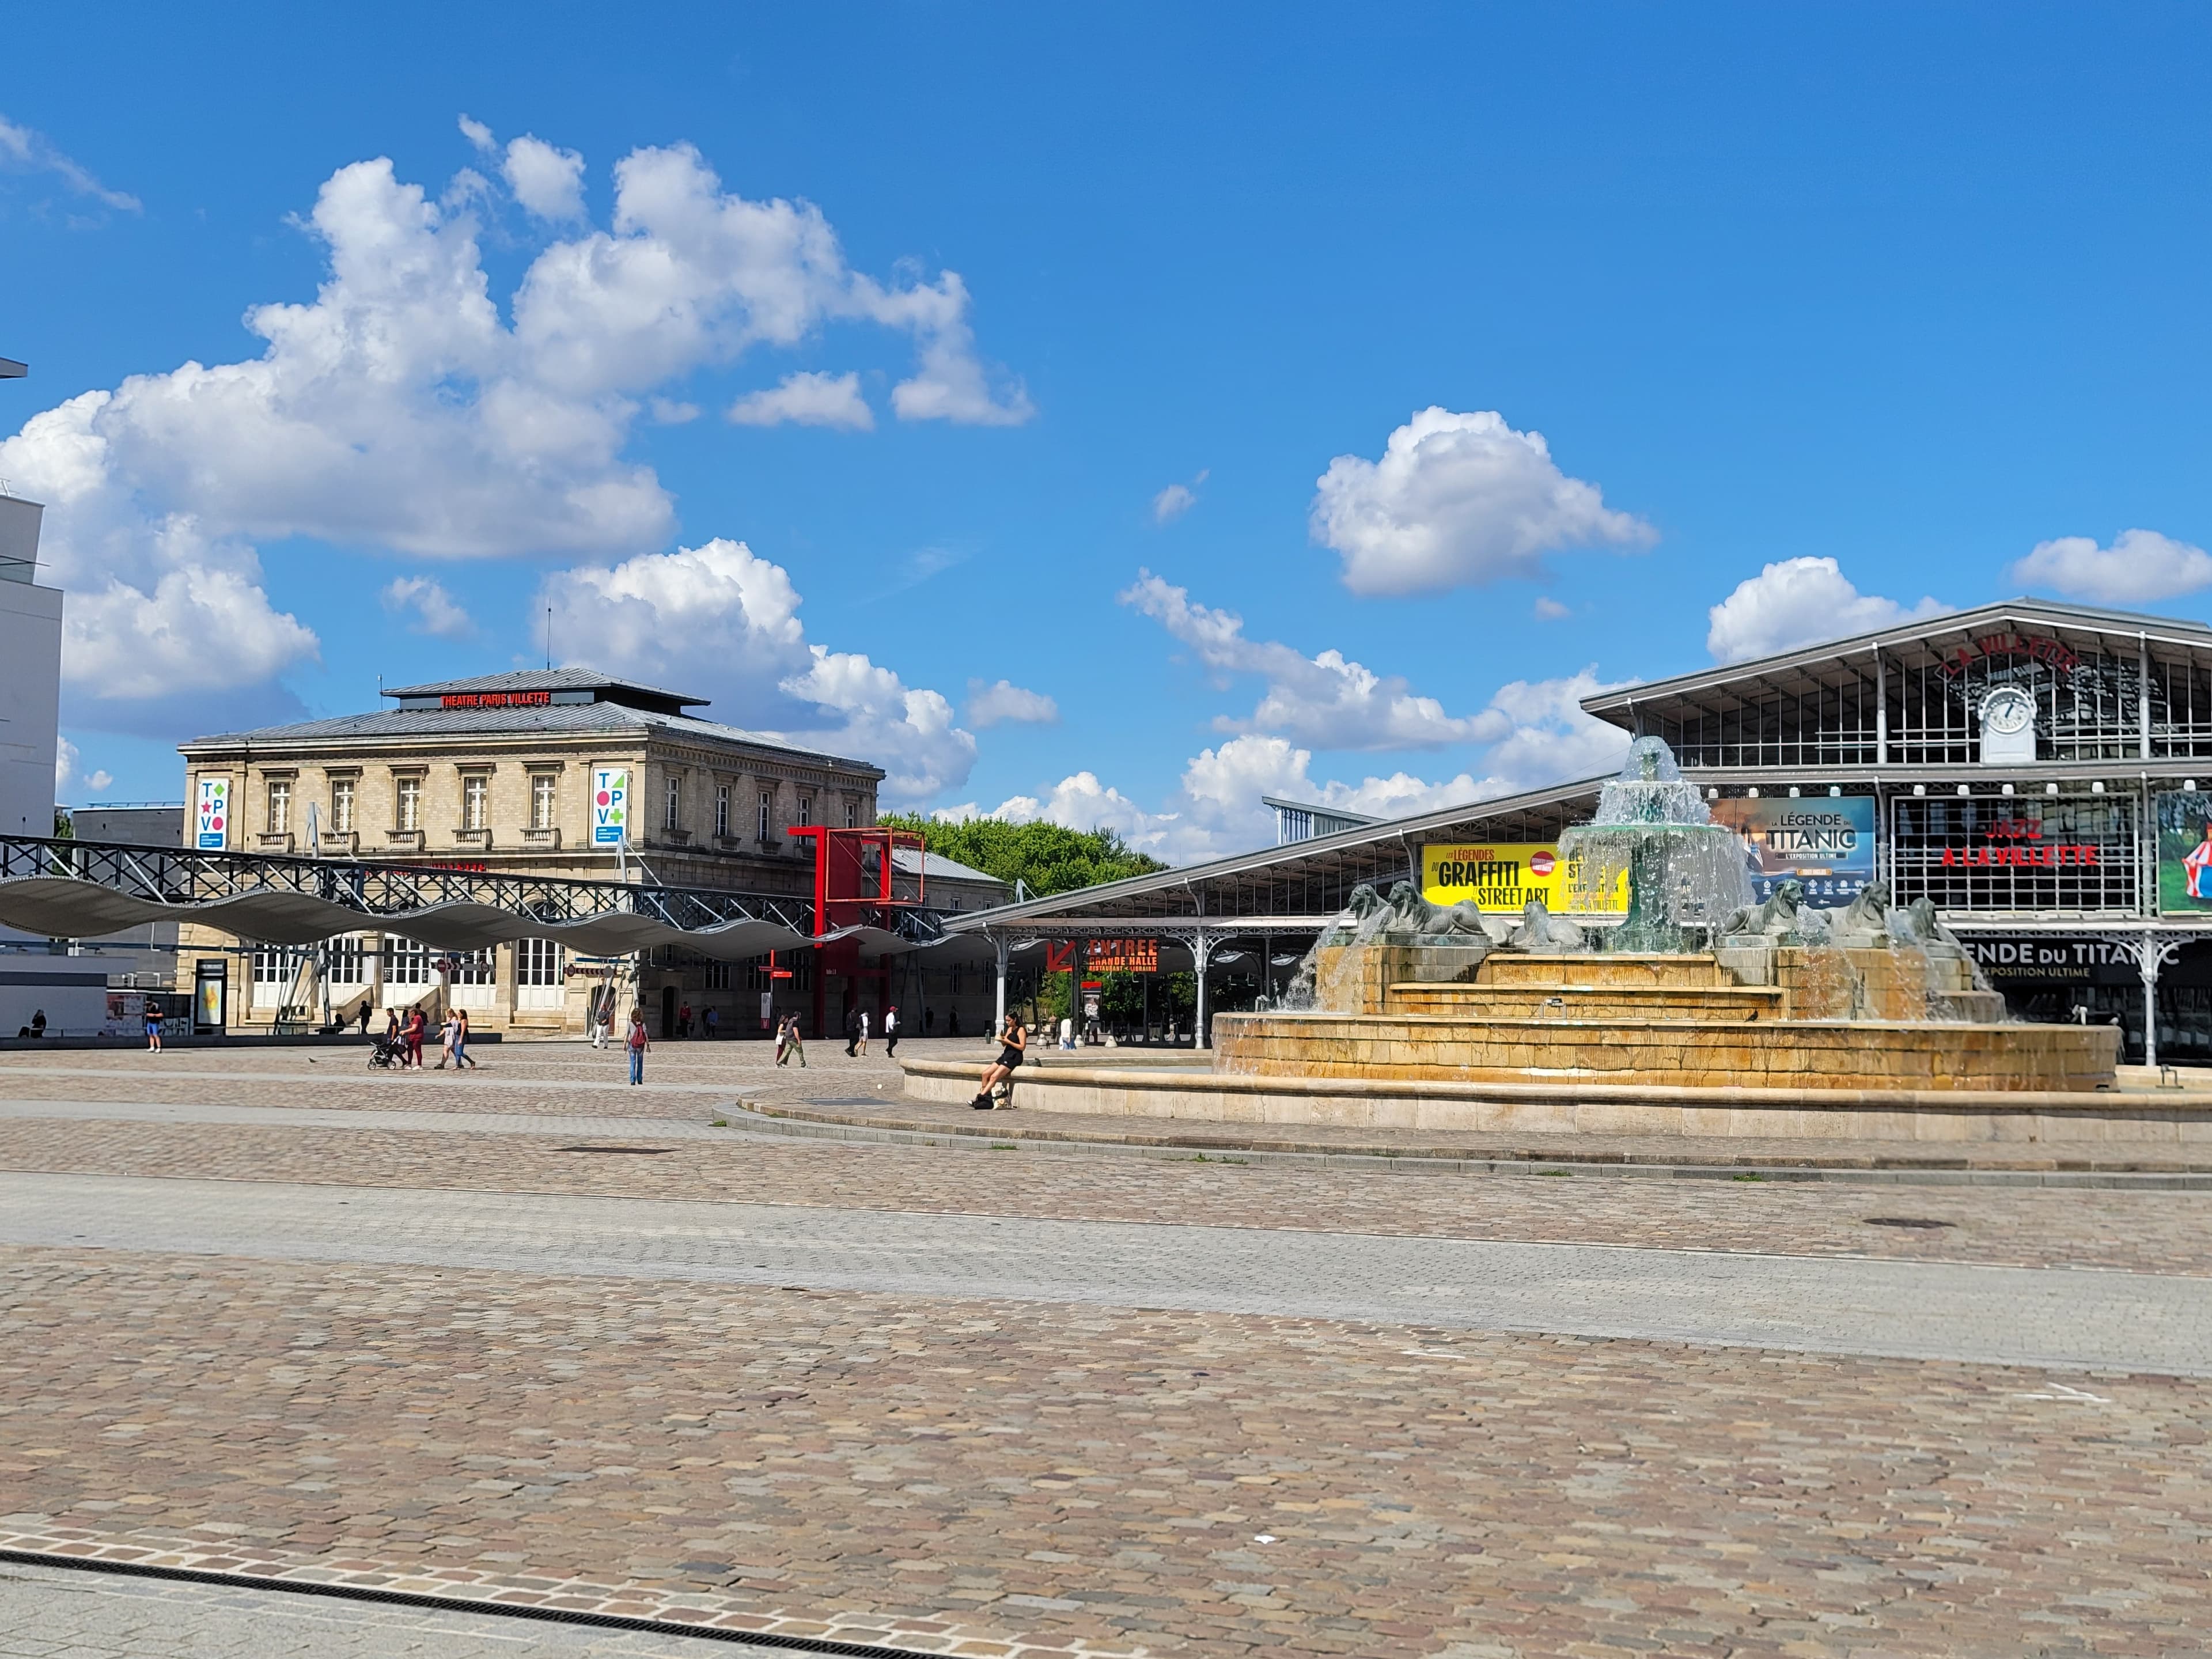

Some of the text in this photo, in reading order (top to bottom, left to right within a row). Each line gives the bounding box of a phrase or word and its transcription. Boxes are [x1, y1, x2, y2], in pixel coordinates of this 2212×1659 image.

[1978, 634, 2080, 673] VILLETTE
[441, 692, 550, 707] THEATRE PARIS VILLETTE
[599, 773, 609, 788] T
[202, 783, 212, 797] T
[612, 790, 623, 806] P
[214, 800, 223, 814] P
[201, 816, 211, 831] V
[598, 809, 609, 824] V
[1781, 812, 1841, 826] LÉGENDE
[1986, 819, 2042, 839] JAZZ
[1766, 829, 1856, 849] TITANIC
[1454, 847, 1494, 861] LÉGENDES
[1963, 847, 1990, 866] LA
[1995, 846, 2097, 866] VILLETTE
[1431, 861, 1520, 887] DU GRAFFITI
[1478, 888, 1523, 905] STREET
[1525, 888, 1550, 905] ART
[1089, 939, 1157, 956] ENTREE
[1961, 943, 2180, 965] ENDE DU TITAC
[1089, 957, 1157, 965] GRANDE HALLE
[1982, 967, 2090, 978] XPOSITION ULTIME
